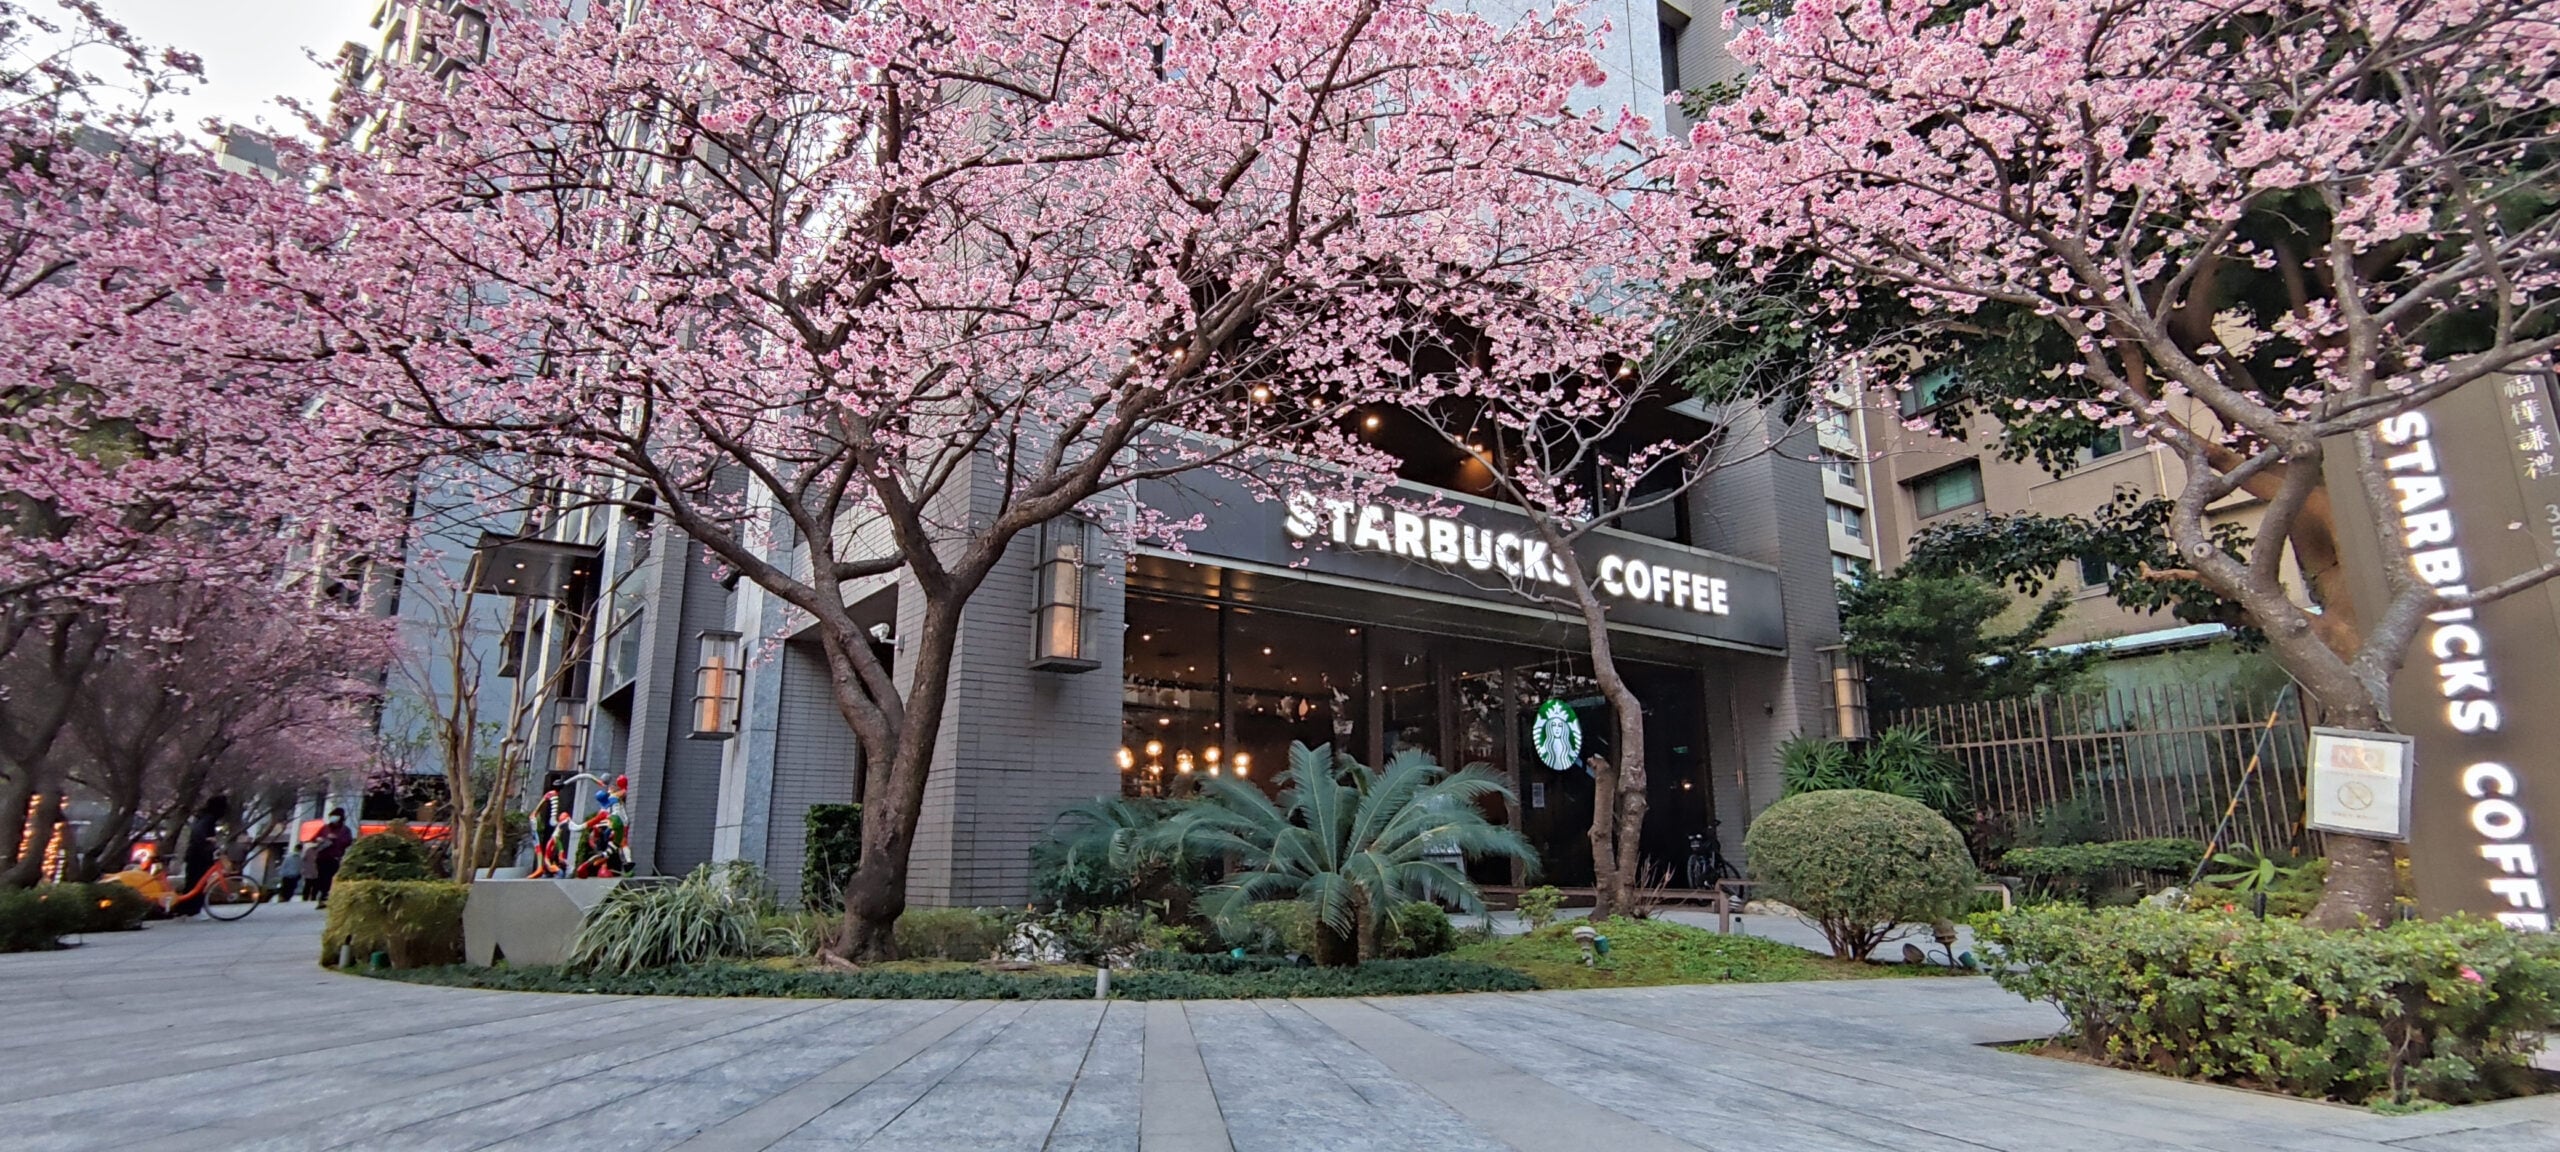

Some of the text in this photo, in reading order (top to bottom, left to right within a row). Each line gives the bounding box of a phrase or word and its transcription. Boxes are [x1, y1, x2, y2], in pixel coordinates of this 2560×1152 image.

[1285, 490, 1730, 615] STARBUCKS COFFEE
[2377, 409, 2499, 733] STARBUCKS
